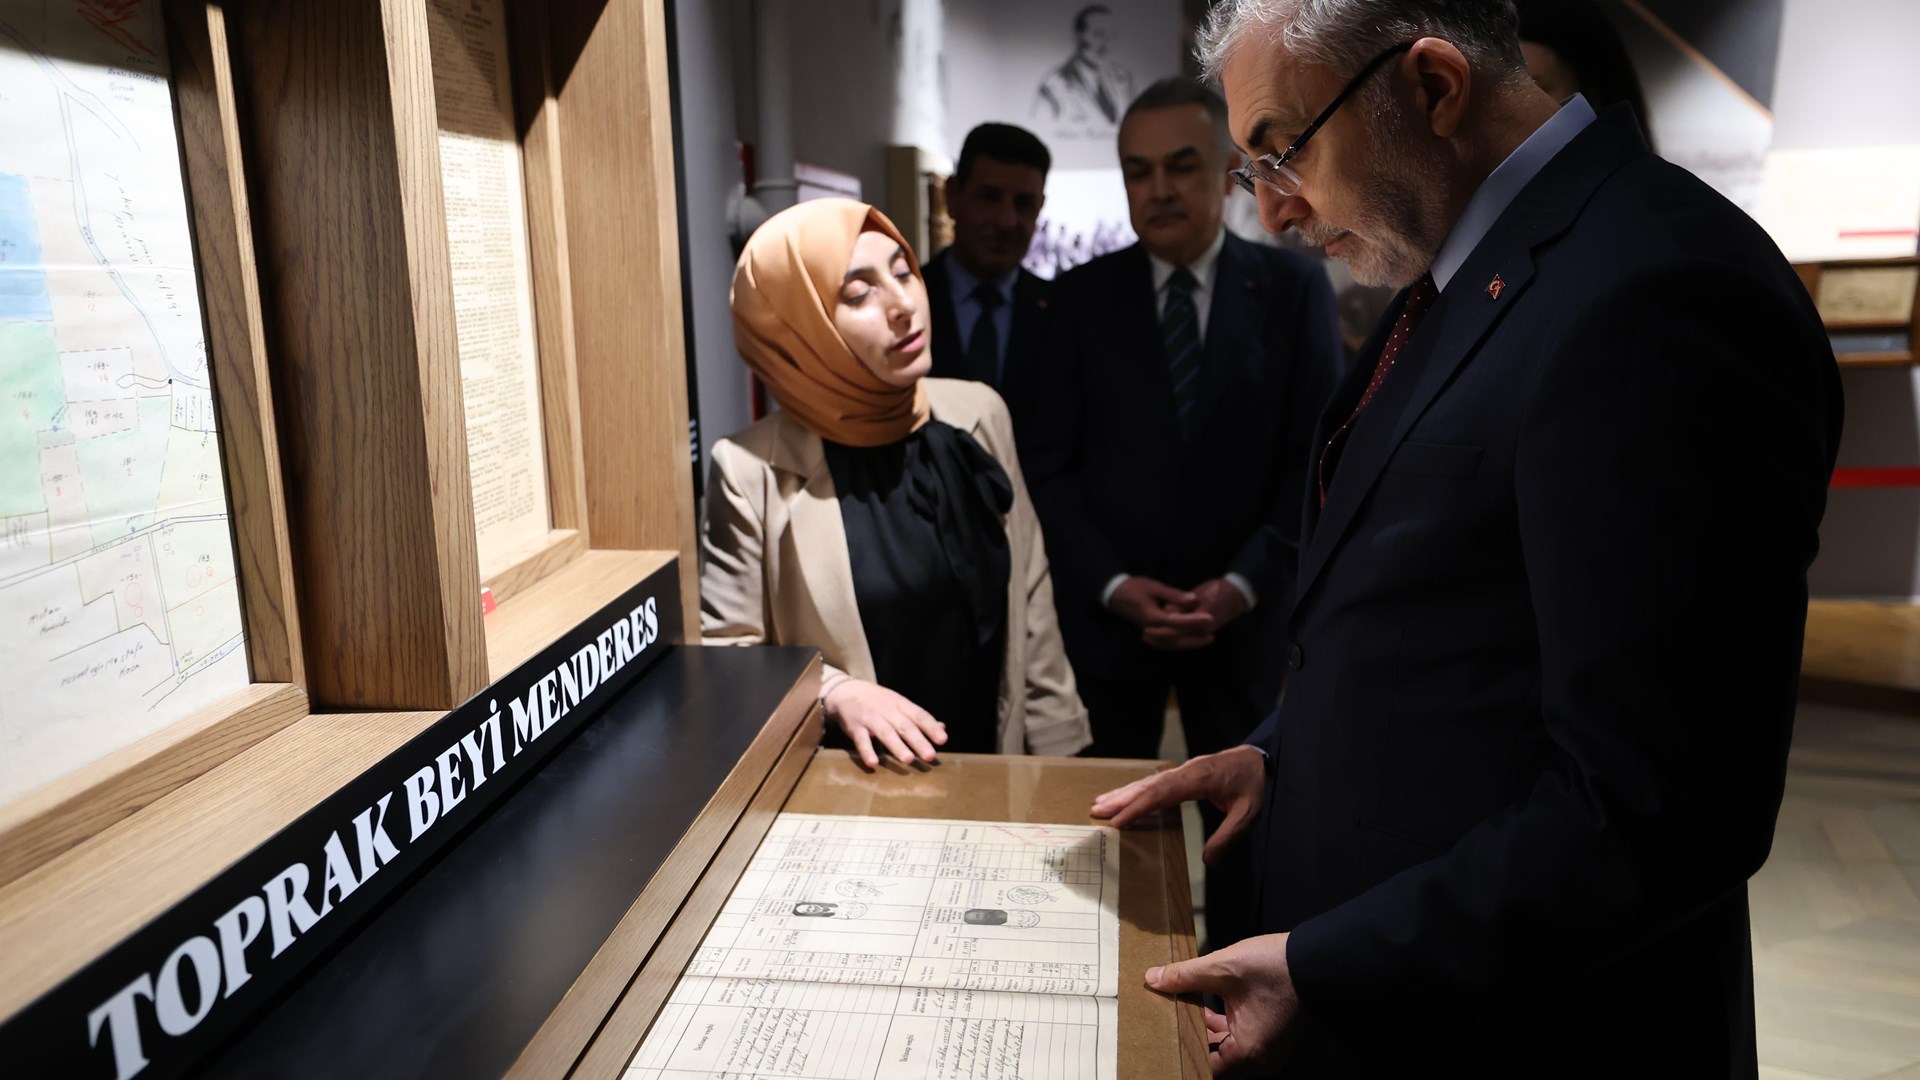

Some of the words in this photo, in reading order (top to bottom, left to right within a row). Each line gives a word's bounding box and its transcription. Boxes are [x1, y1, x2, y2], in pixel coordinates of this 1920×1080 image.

[88, 791, 401, 1080] TOPRAK
[403, 698, 507, 844] BEYİ
[508, 596, 659, 757] MENDERES
